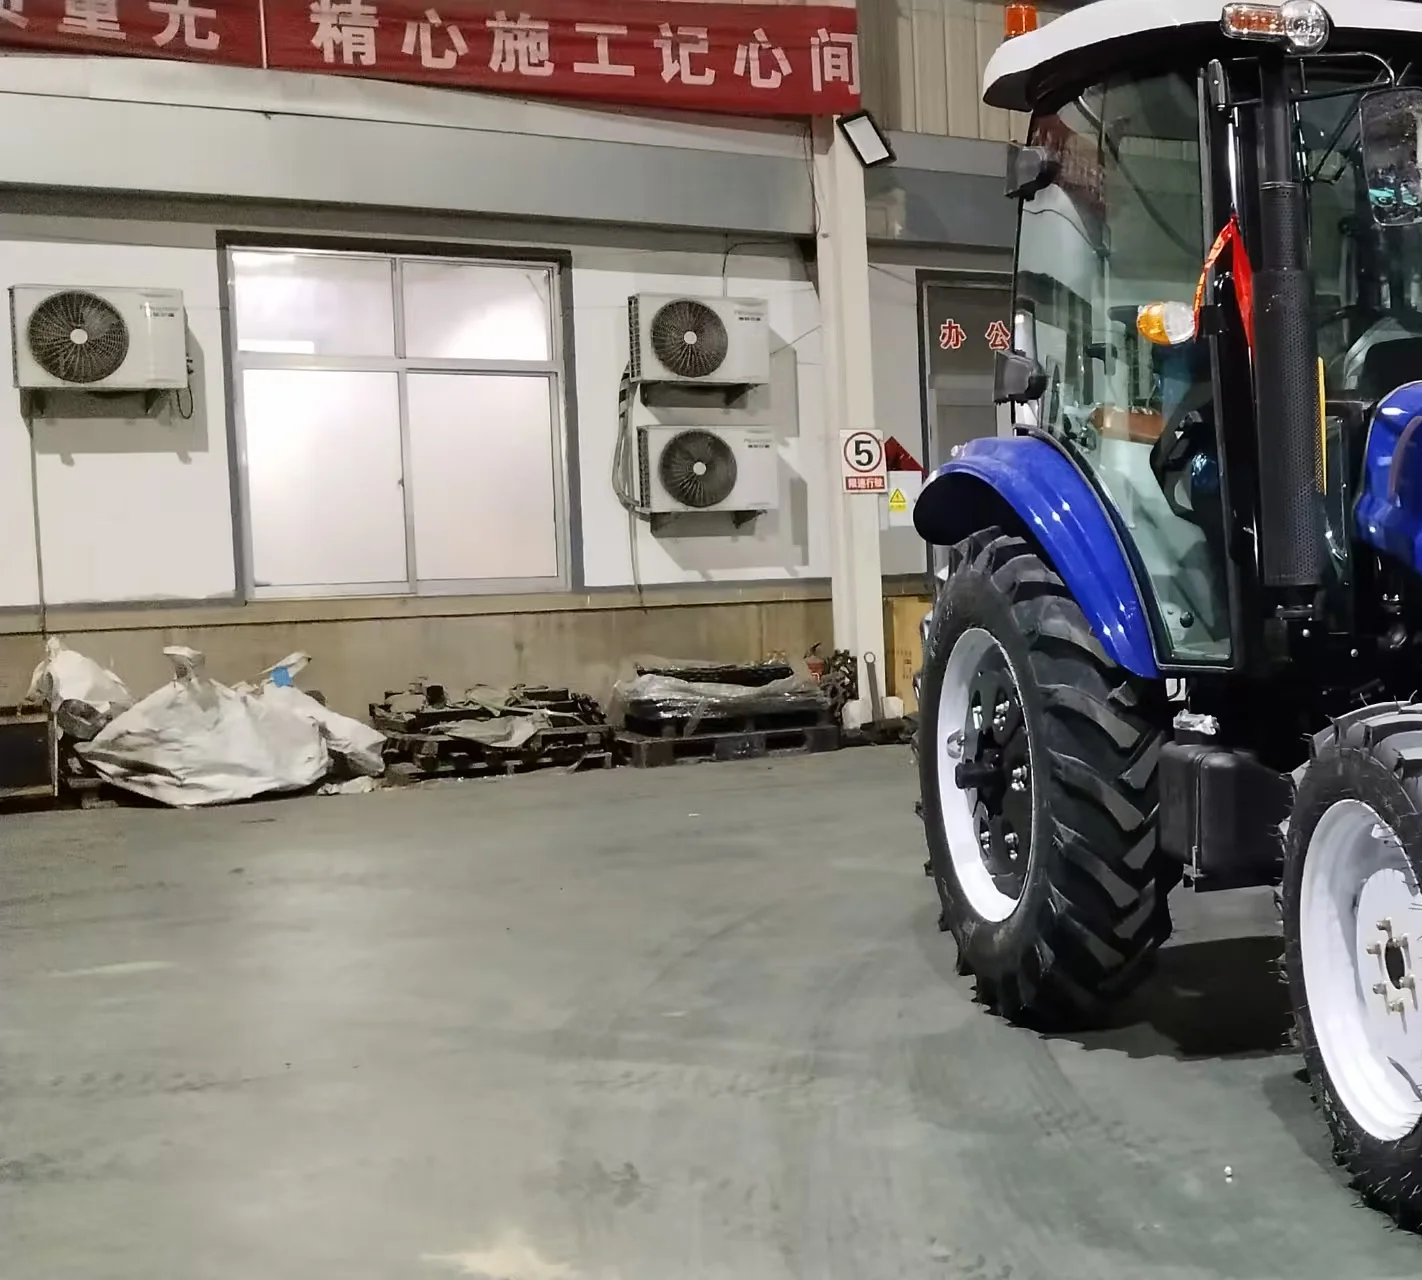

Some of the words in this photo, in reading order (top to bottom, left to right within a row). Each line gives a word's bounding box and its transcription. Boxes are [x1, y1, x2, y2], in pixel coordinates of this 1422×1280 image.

[310, 0, 860, 94] 精心施工记心间
[940, 319, 1011, 350] 办公
[854, 440, 874, 467] 5
